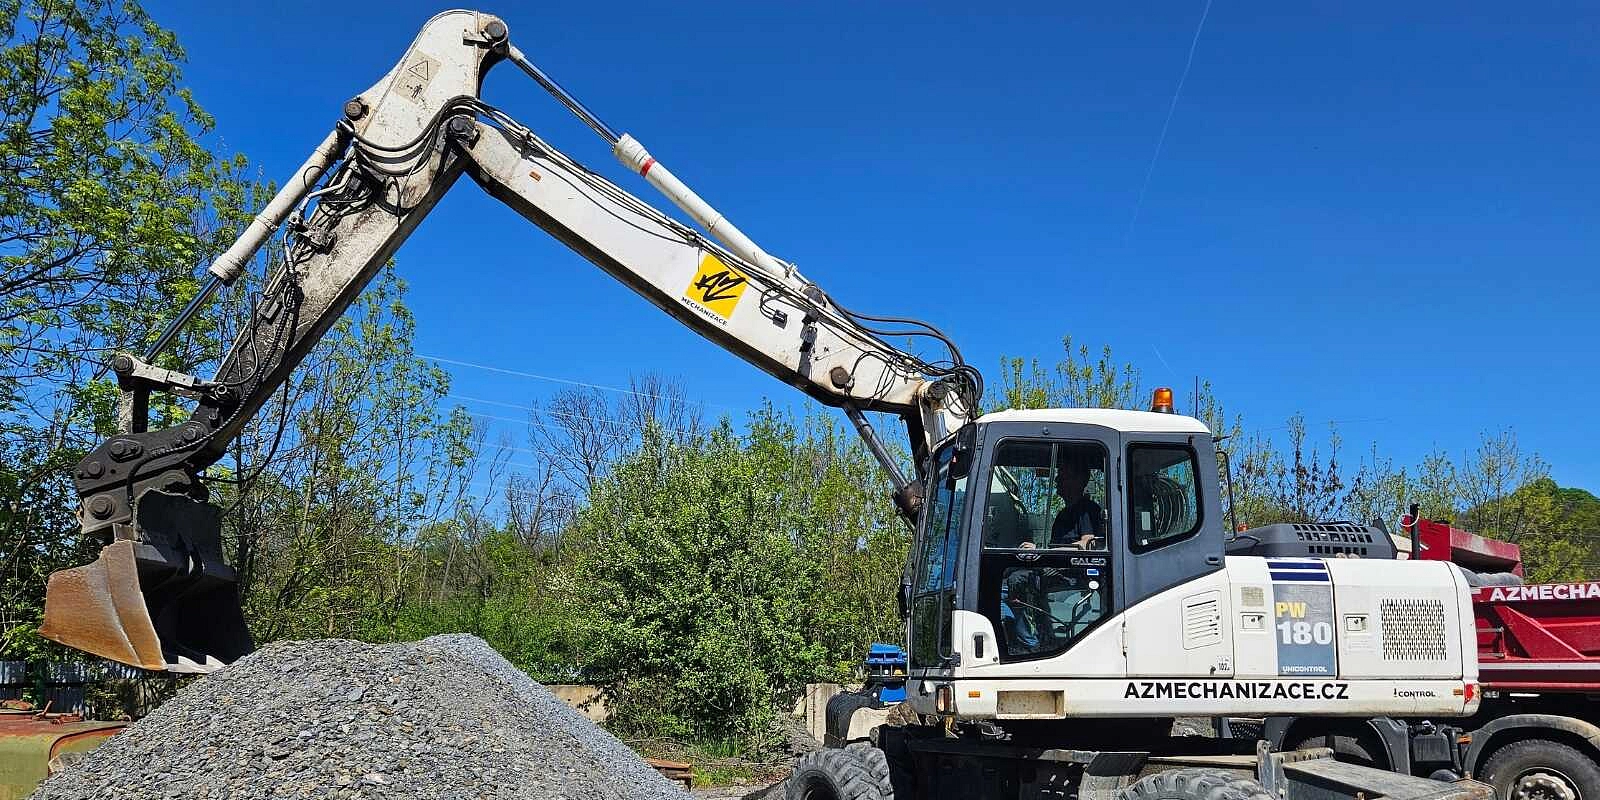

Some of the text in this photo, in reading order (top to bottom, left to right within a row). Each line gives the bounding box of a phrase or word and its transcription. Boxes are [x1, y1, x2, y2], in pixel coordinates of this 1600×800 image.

[681, 297, 728, 327] MECHANIZACE
[1275, 601, 1307, 618] PW
[1277, 621, 1332, 645] 180
[1282, 665, 1328, 673] UNICONTROL
[1124, 682, 1349, 700] AZMECHANIZACE.CZ
